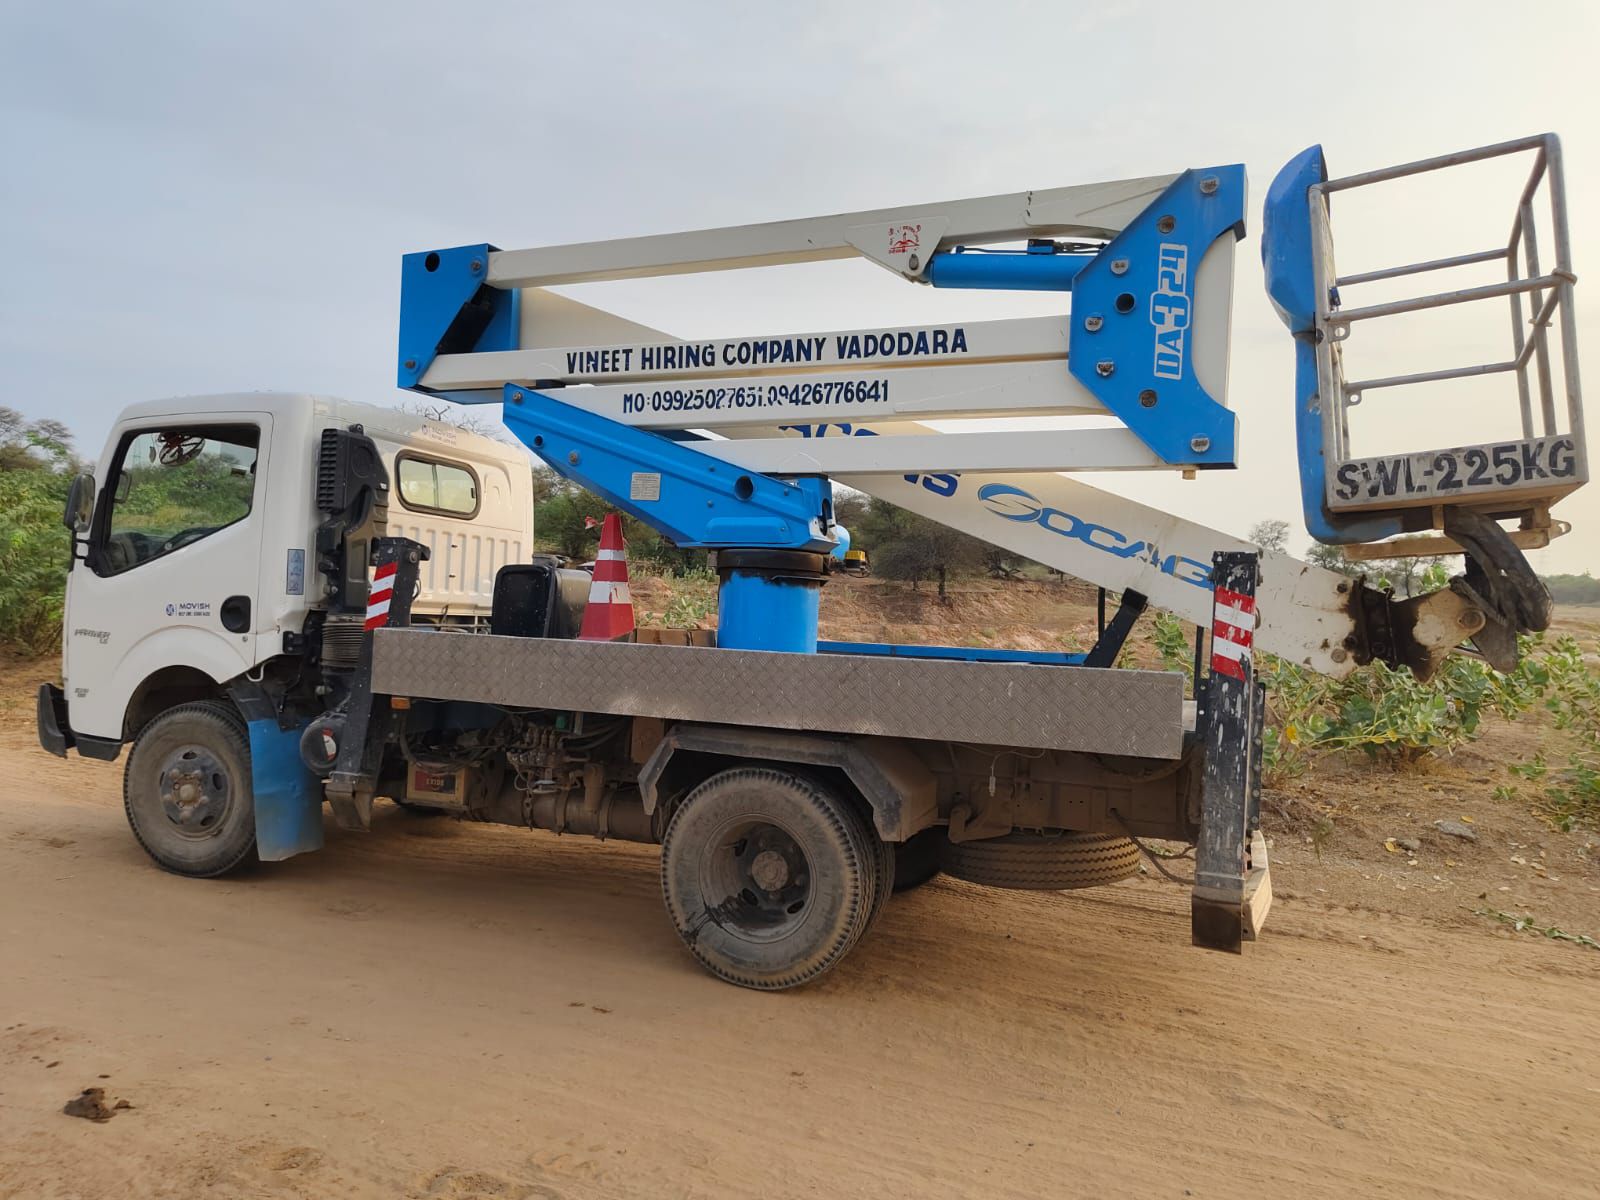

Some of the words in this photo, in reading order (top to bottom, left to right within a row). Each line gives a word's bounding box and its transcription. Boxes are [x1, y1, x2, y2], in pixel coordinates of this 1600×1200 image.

[1151, 243, 1190, 380] DA324
[566, 348, 633, 374] VINEET
[641, 343, 716, 370] HIRING
[722, 336, 827, 366] COMPANY
[836, 328, 968, 360] VADODARA
[179, 602, 210, 610] MOVISH
